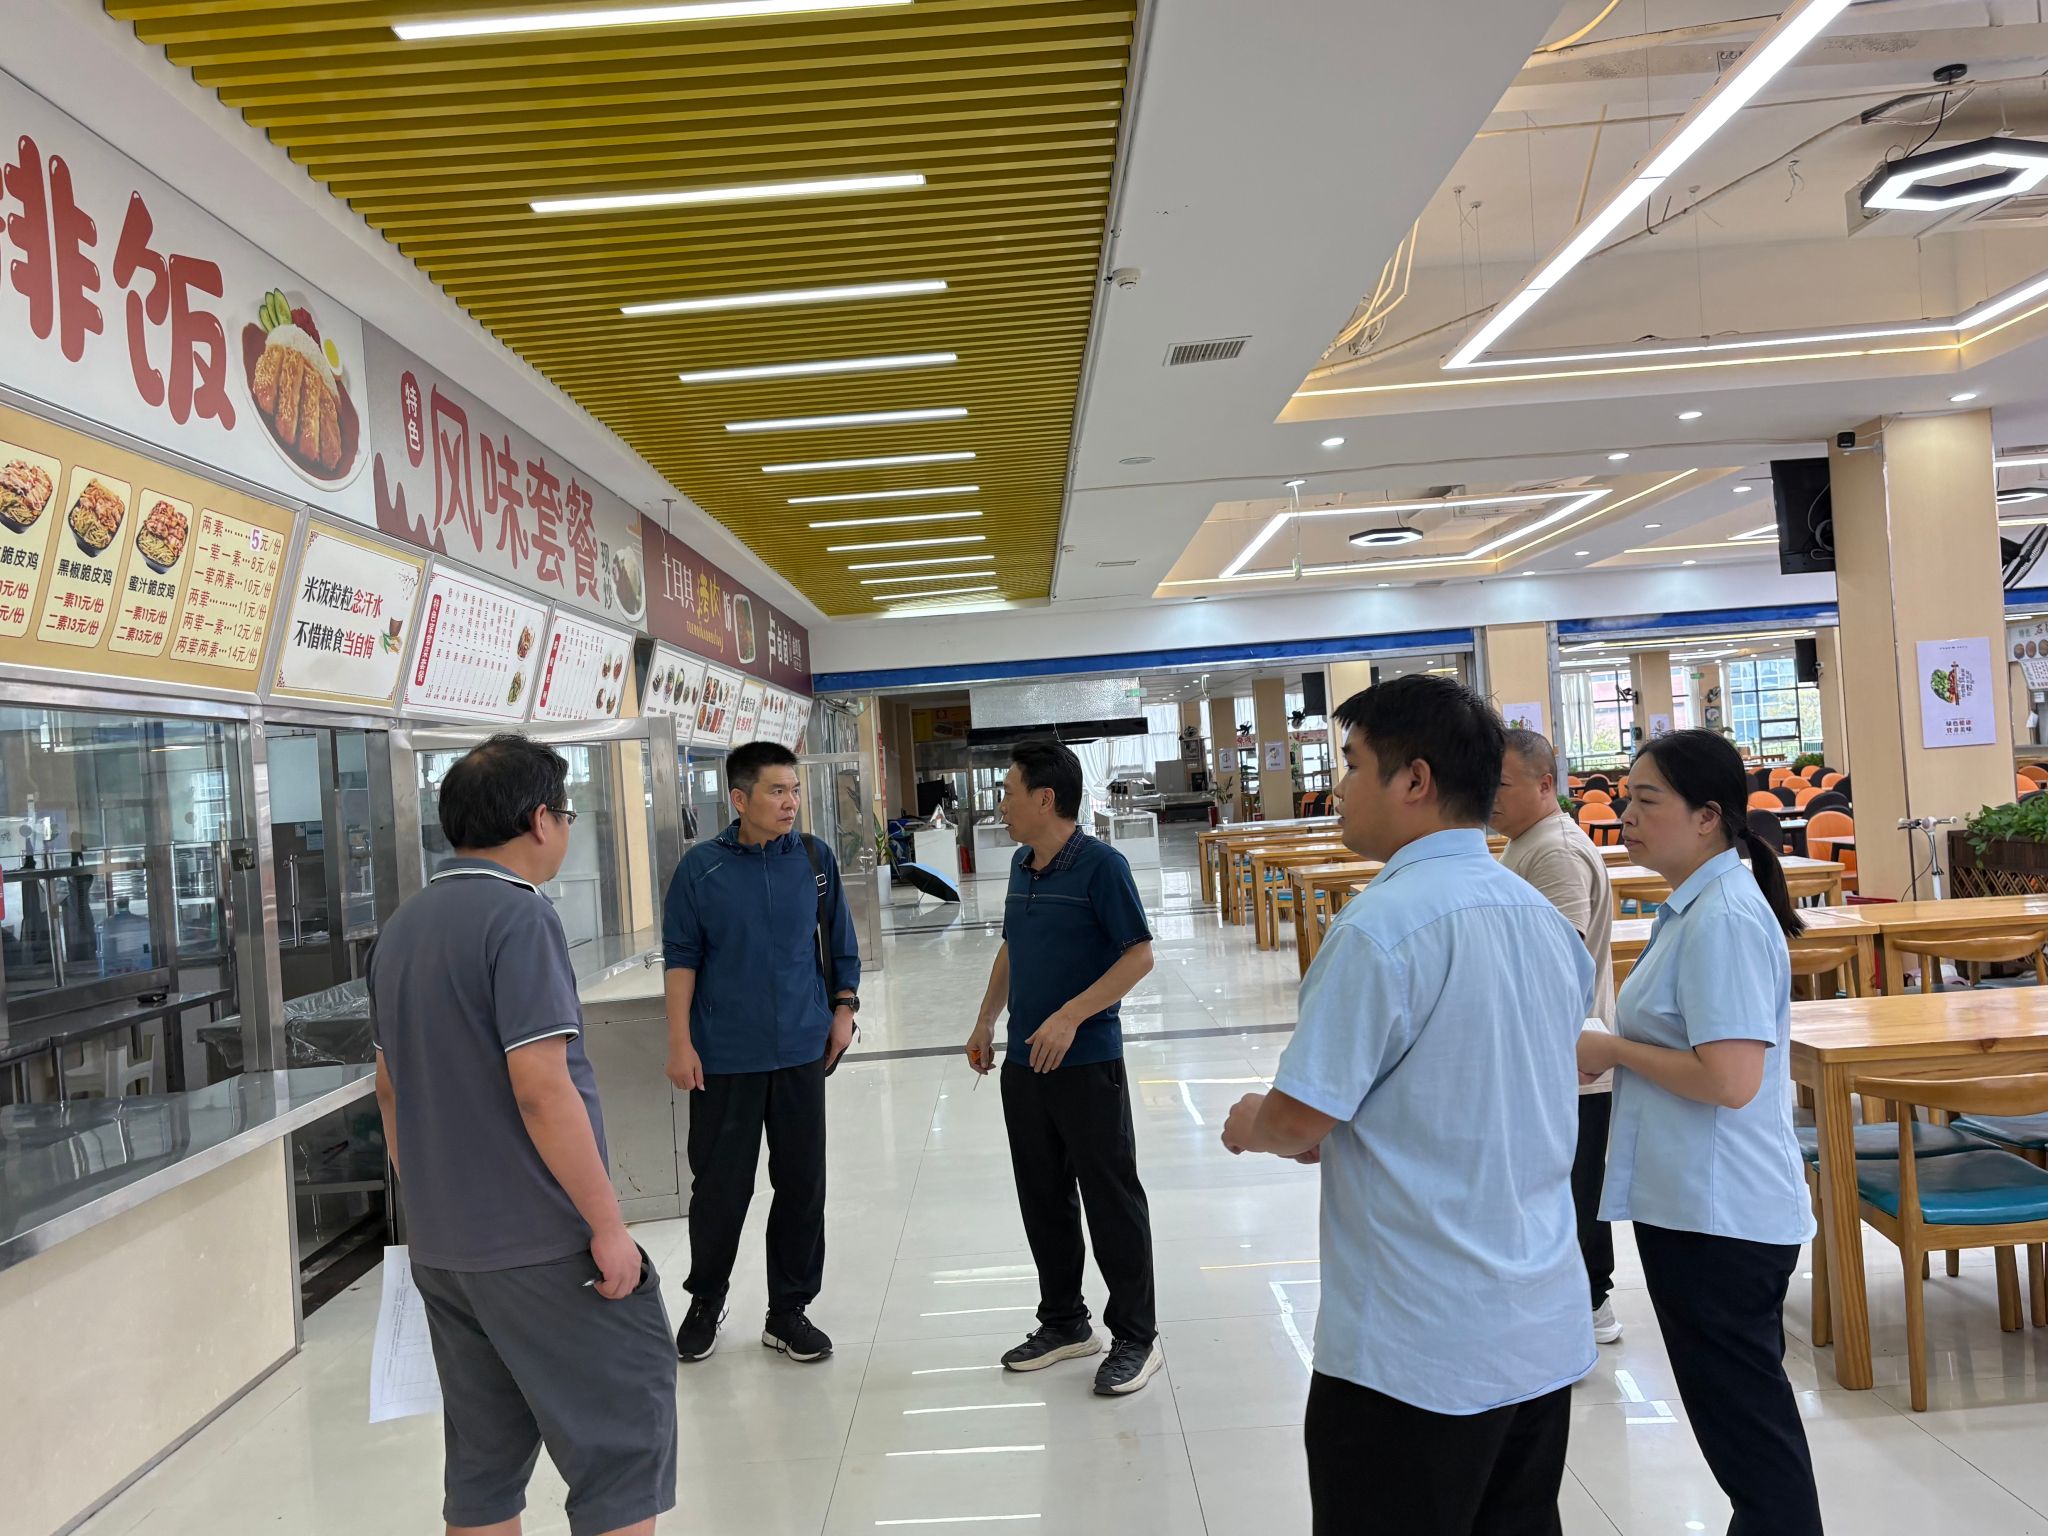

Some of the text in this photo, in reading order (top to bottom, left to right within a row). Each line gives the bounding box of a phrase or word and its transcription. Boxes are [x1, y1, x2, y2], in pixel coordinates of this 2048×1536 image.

[405, 382, 421, 451] 特色
[431, 383, 601, 603] 风味套餐
[56, 558, 113, 587] 黑椒脆皮鸡
[128, 575, 176, 600] 蜜汁脆皮鸡
[301, 576, 384, 619] 米饭粒粒念汗水
[54, 592, 105, 614] 一素11元/份
[125, 605, 168, 625] 一素11元/份
[46, 614, 100, 636] 二素13元/份
[116, 626, 163, 646] 二素13元/份
[293, 620, 376, 660] 不惜粮食当自悔
